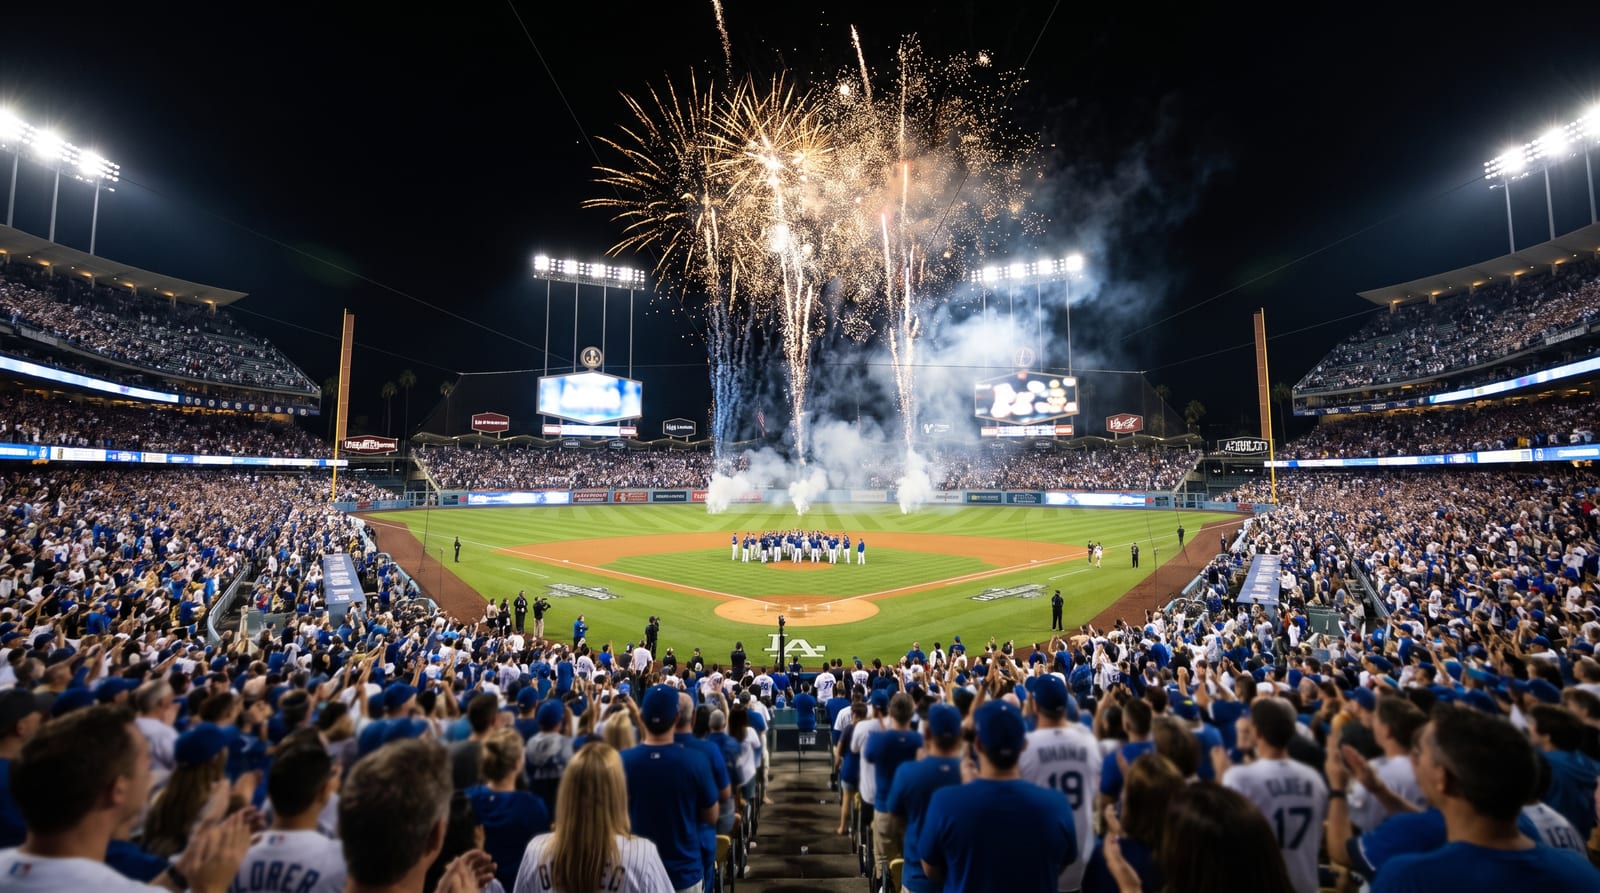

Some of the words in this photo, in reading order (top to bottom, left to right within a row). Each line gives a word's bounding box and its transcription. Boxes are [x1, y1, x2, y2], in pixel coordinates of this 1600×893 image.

[764, 633, 826, 657] LA
[1048, 770, 1083, 810] 19
[1274, 806, 1313, 849] 17
